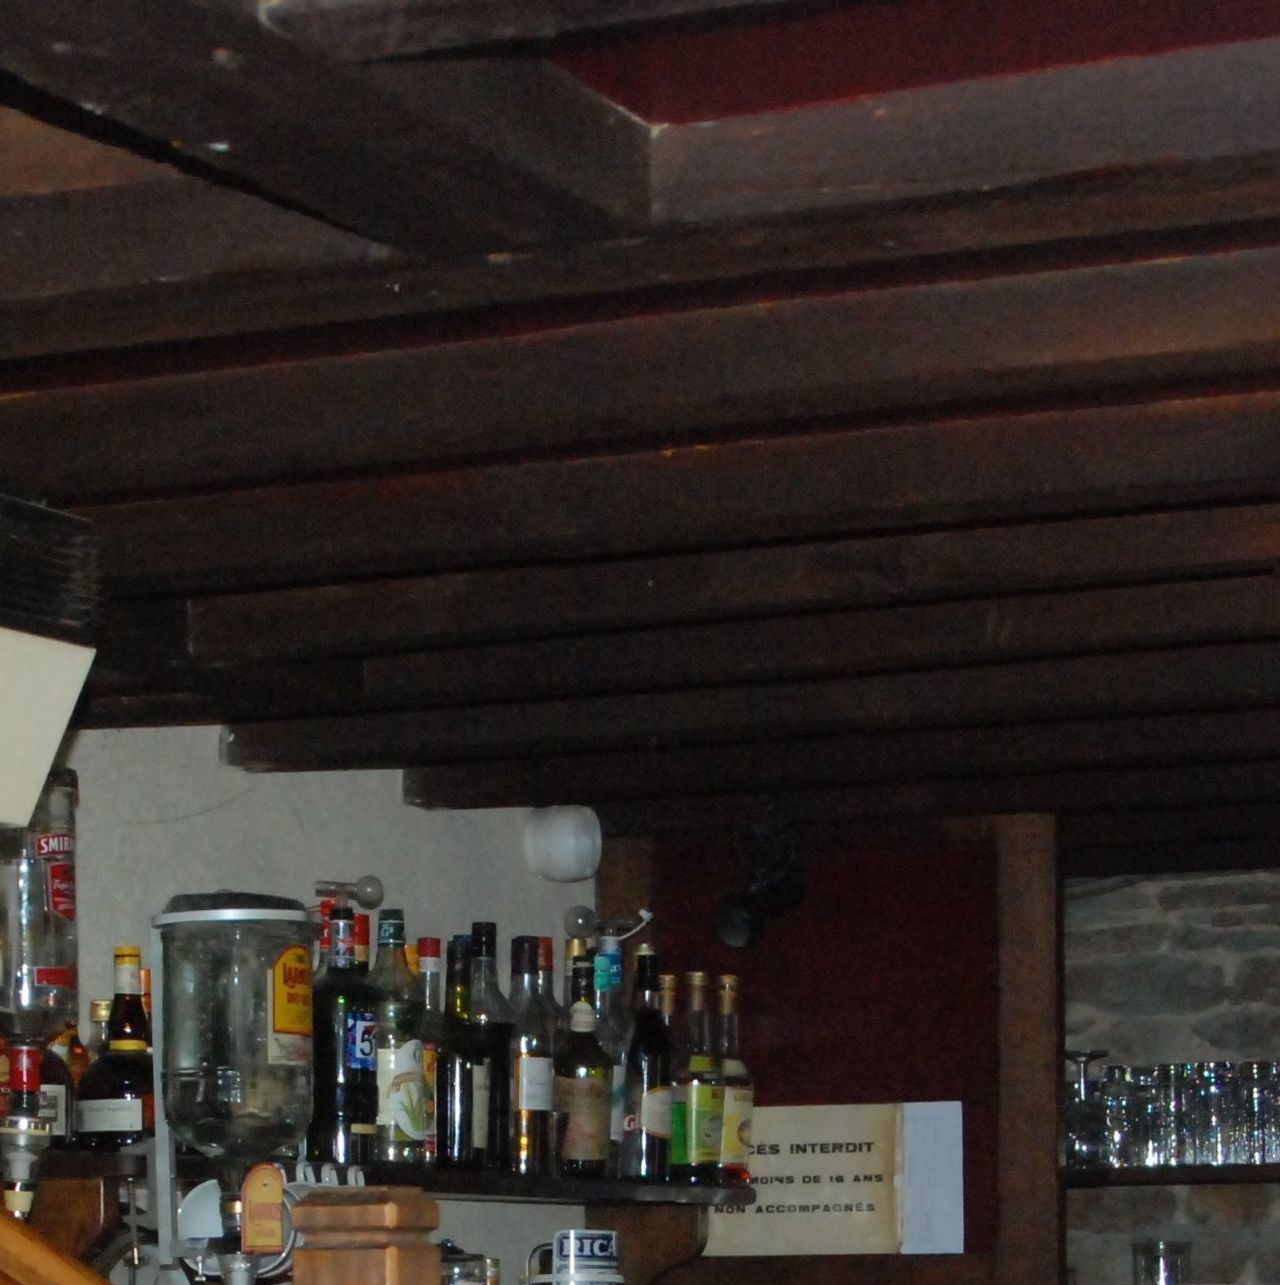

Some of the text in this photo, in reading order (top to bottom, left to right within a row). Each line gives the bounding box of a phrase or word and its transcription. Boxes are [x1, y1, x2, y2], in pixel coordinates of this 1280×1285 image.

[789, 1142, 874, 1154] INTERDIT
[802, 1175, 822, 1183] DE
[852, 1174, 884, 1183] ANS
[714, 1204, 746, 1214] NON
